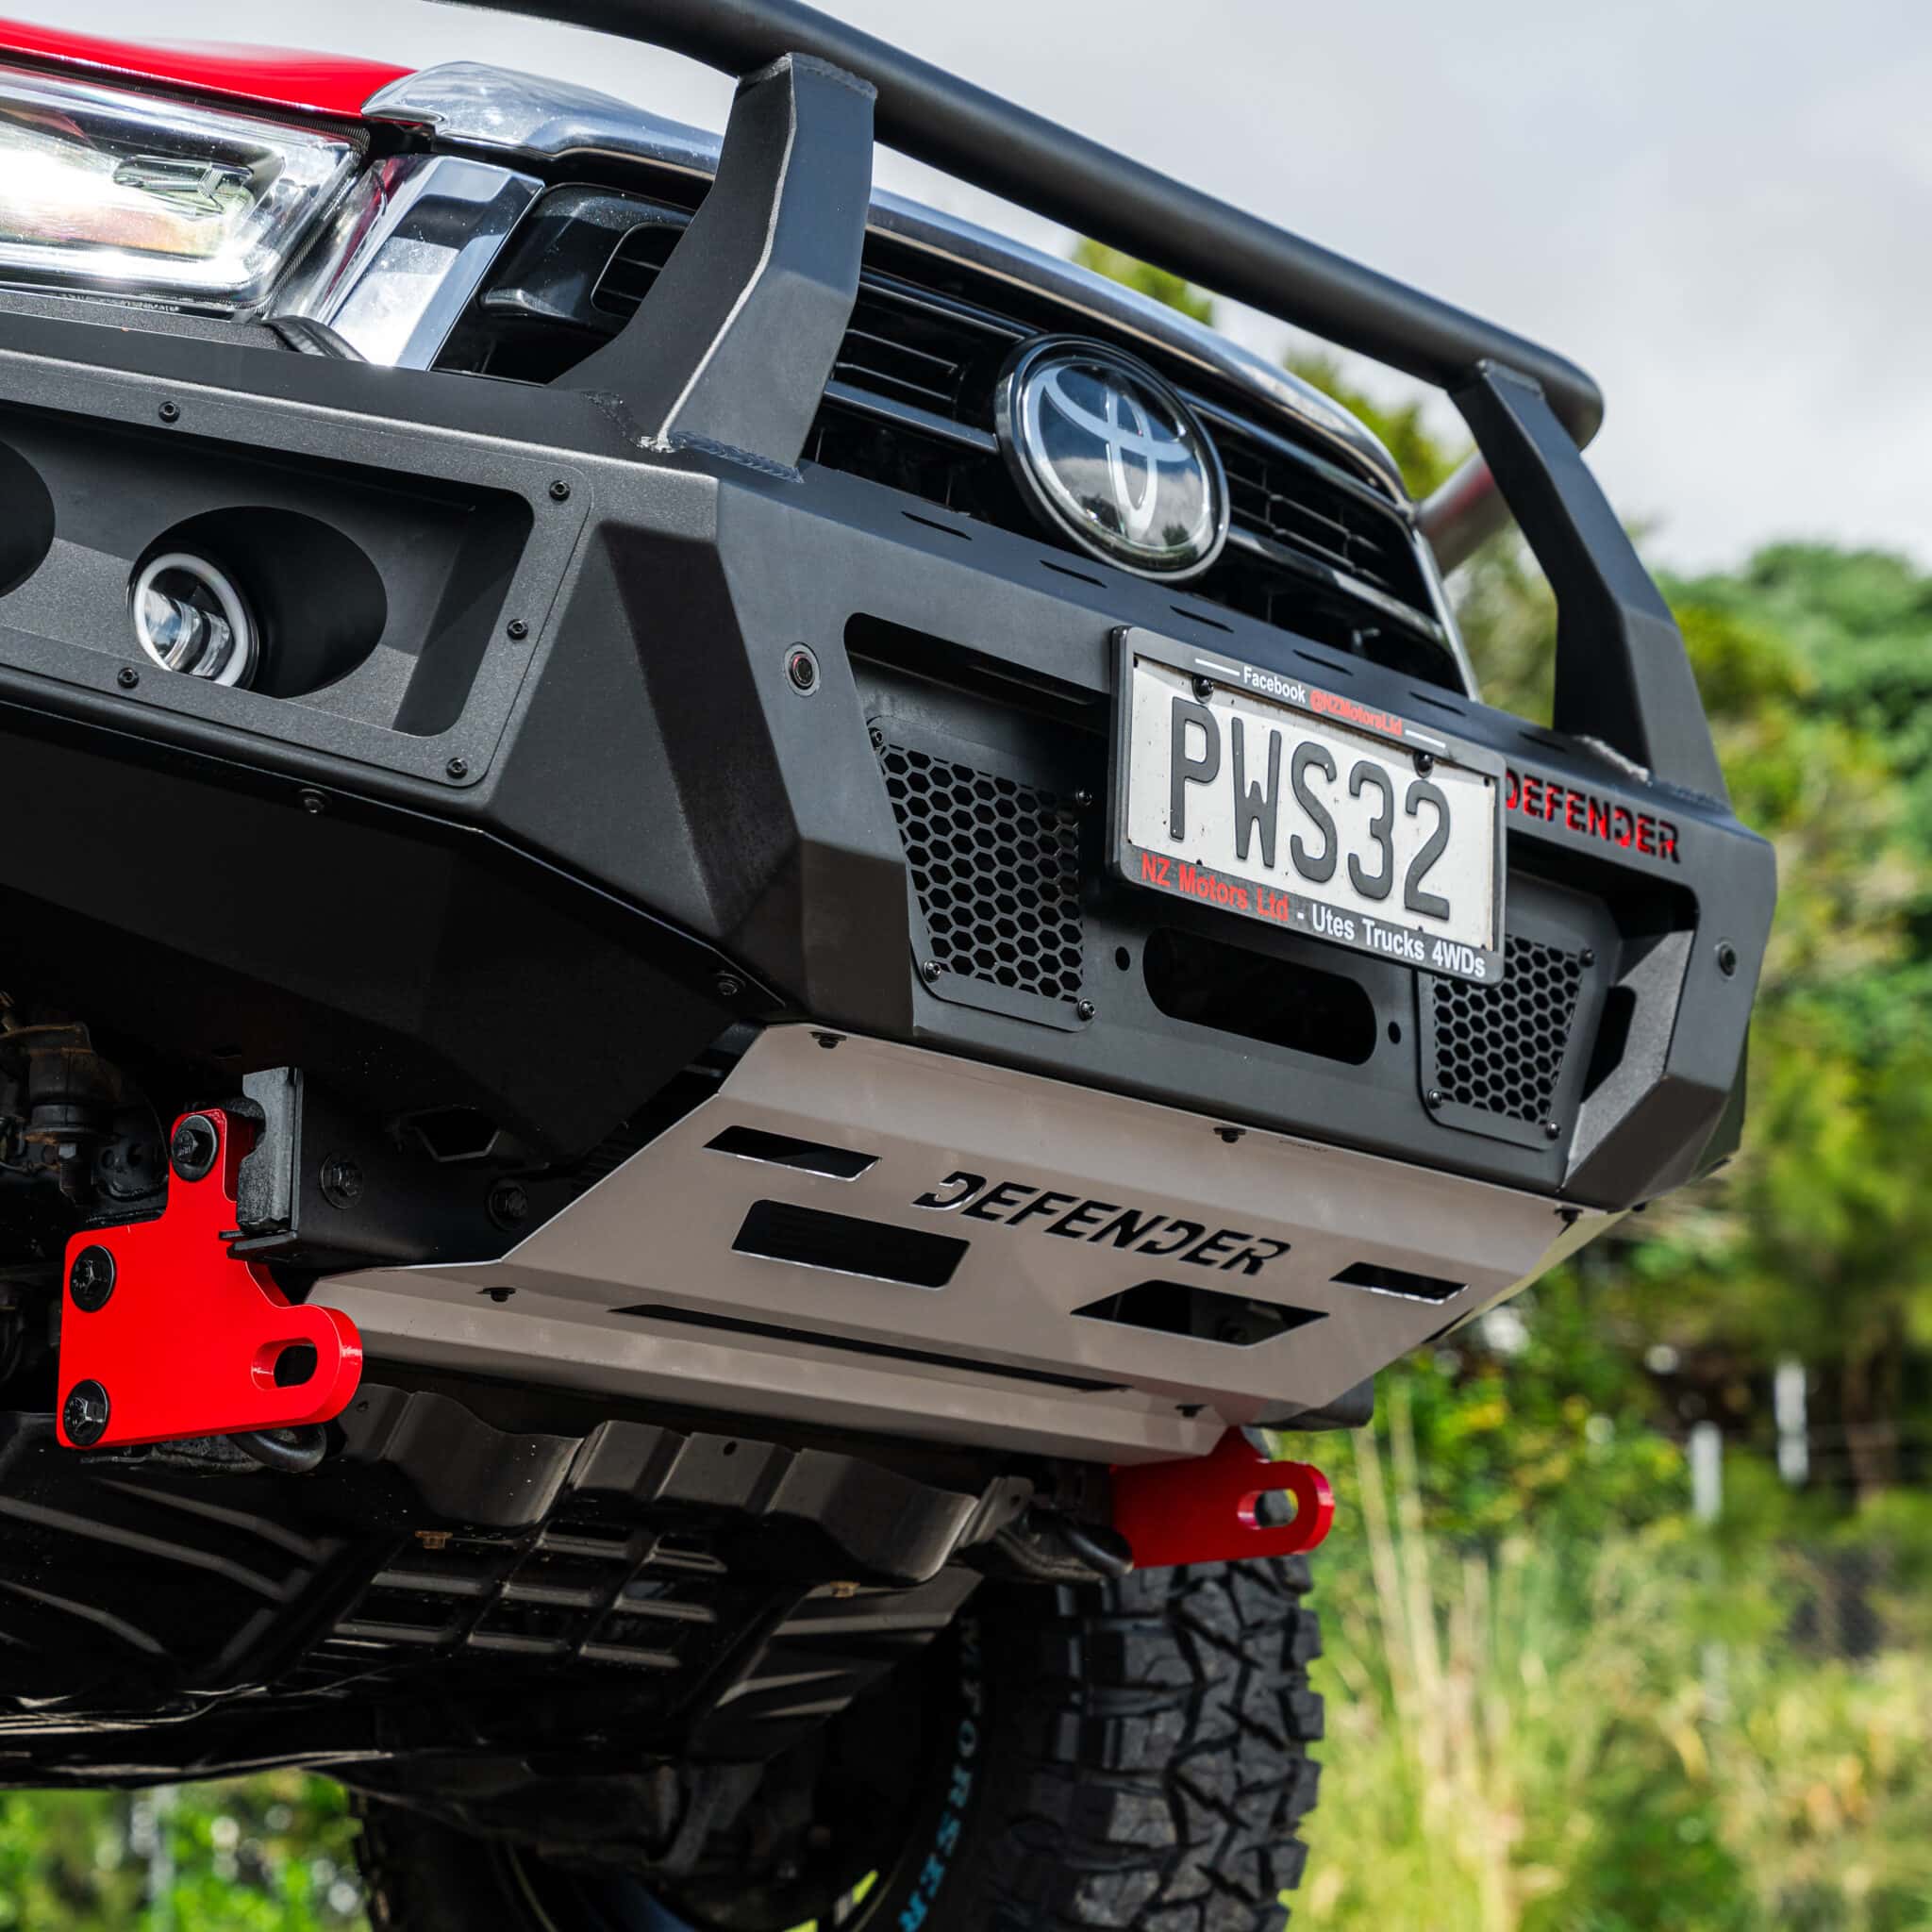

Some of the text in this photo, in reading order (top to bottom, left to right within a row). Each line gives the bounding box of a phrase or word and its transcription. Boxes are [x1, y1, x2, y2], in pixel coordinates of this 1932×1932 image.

[1243, 666, 1403, 737] Facebook @NZMotorsLtd
[1169, 695, 1451, 922] PWS32
[1507, 767, 1681, 865] DEFENDER
[1141, 852, 1171, 888] NZ
[1179, 863, 1248, 910] Motors
[1257, 885, 1291, 922] Ltd
[1312, 903, 1355, 941] Utes
[1362, 918, 1424, 961] Trucks
[1432, 940, 1486, 978] 4WDs
[911, 1170, 1291, 1275] DEFENDER
